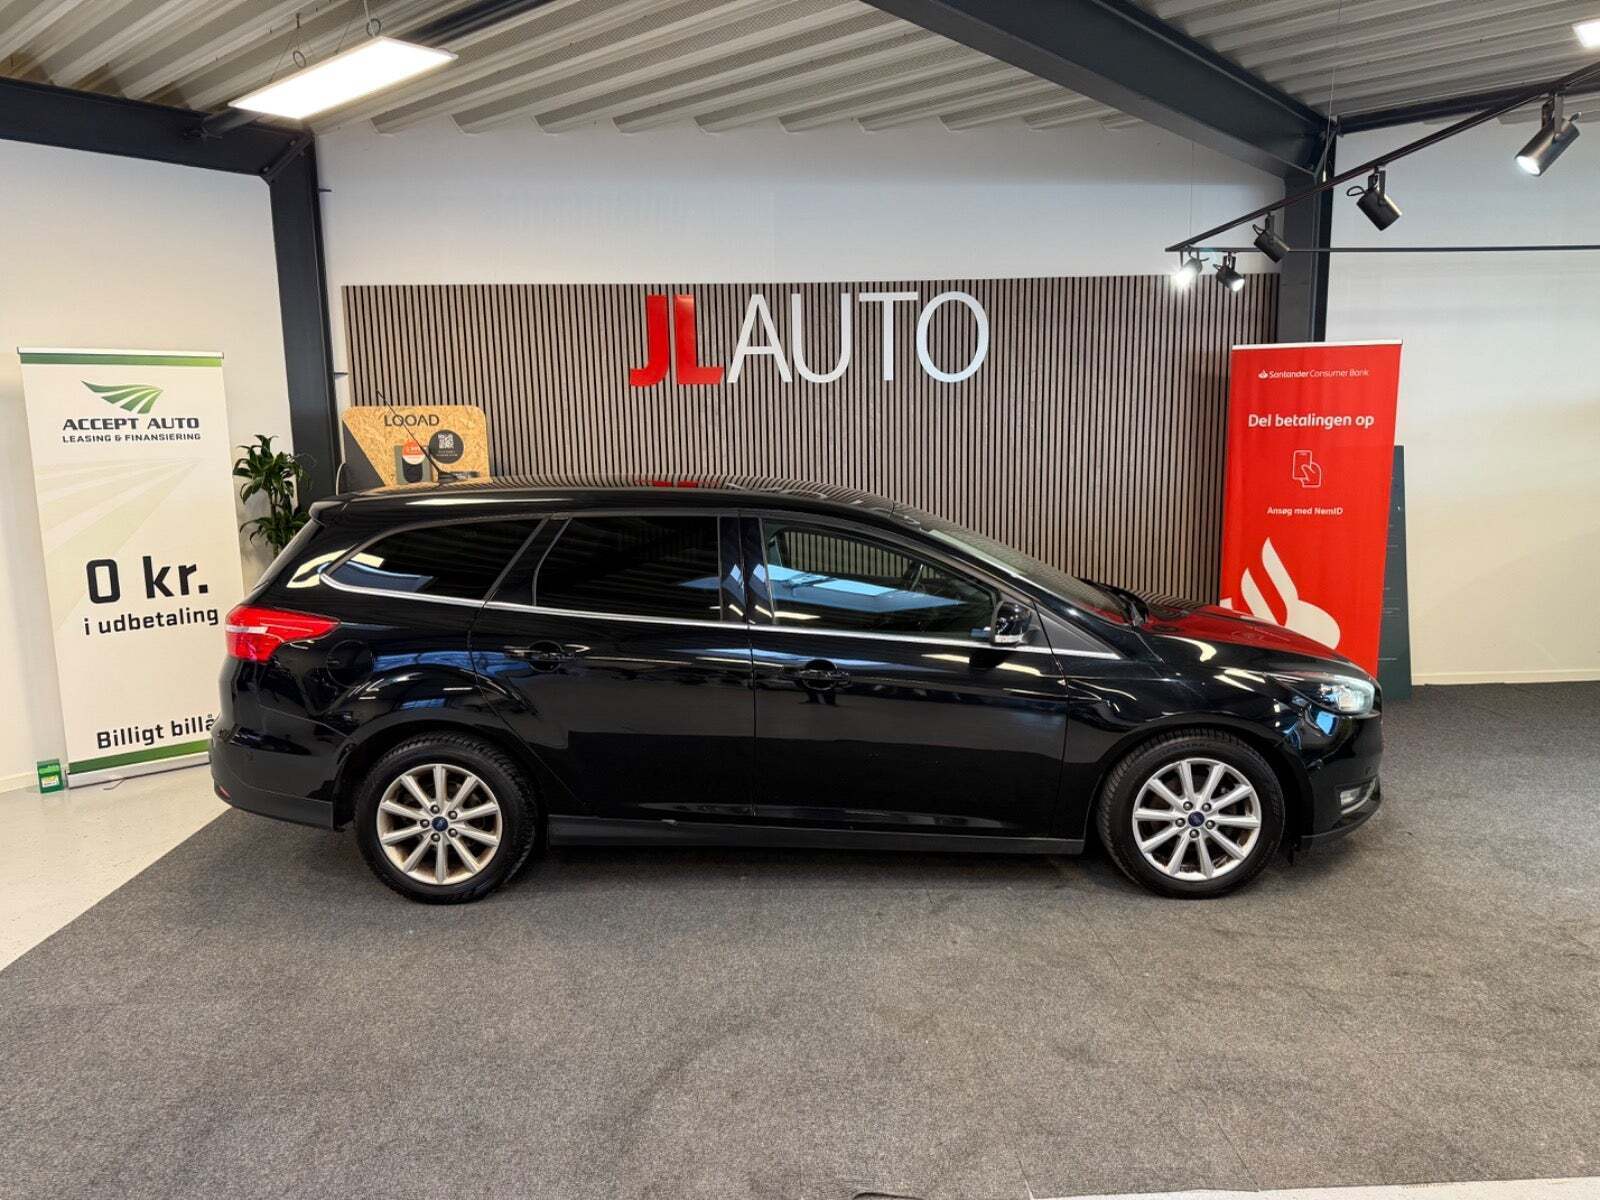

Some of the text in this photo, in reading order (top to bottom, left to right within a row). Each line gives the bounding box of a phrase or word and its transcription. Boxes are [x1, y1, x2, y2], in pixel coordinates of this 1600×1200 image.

[1268, 370, 1309, 379] Santander
[1349, 368, 1369, 376] Bank
[62, 416, 200, 431] ACCEPT AUTO
[384, 414, 440, 427] LOOAD
[1248, 413, 1375, 430] Del betalingen op
[62, 434, 111, 443] LEASING
[125, 432, 201, 441] FINANSIERING
[1294, 507, 1312, 515] med
[1314, 507, 1343, 515] NemID
[86, 555, 209, 604] 0 kr.
[84, 607, 219, 636] i udbetaling
[96, 726, 165, 750] Billigt
